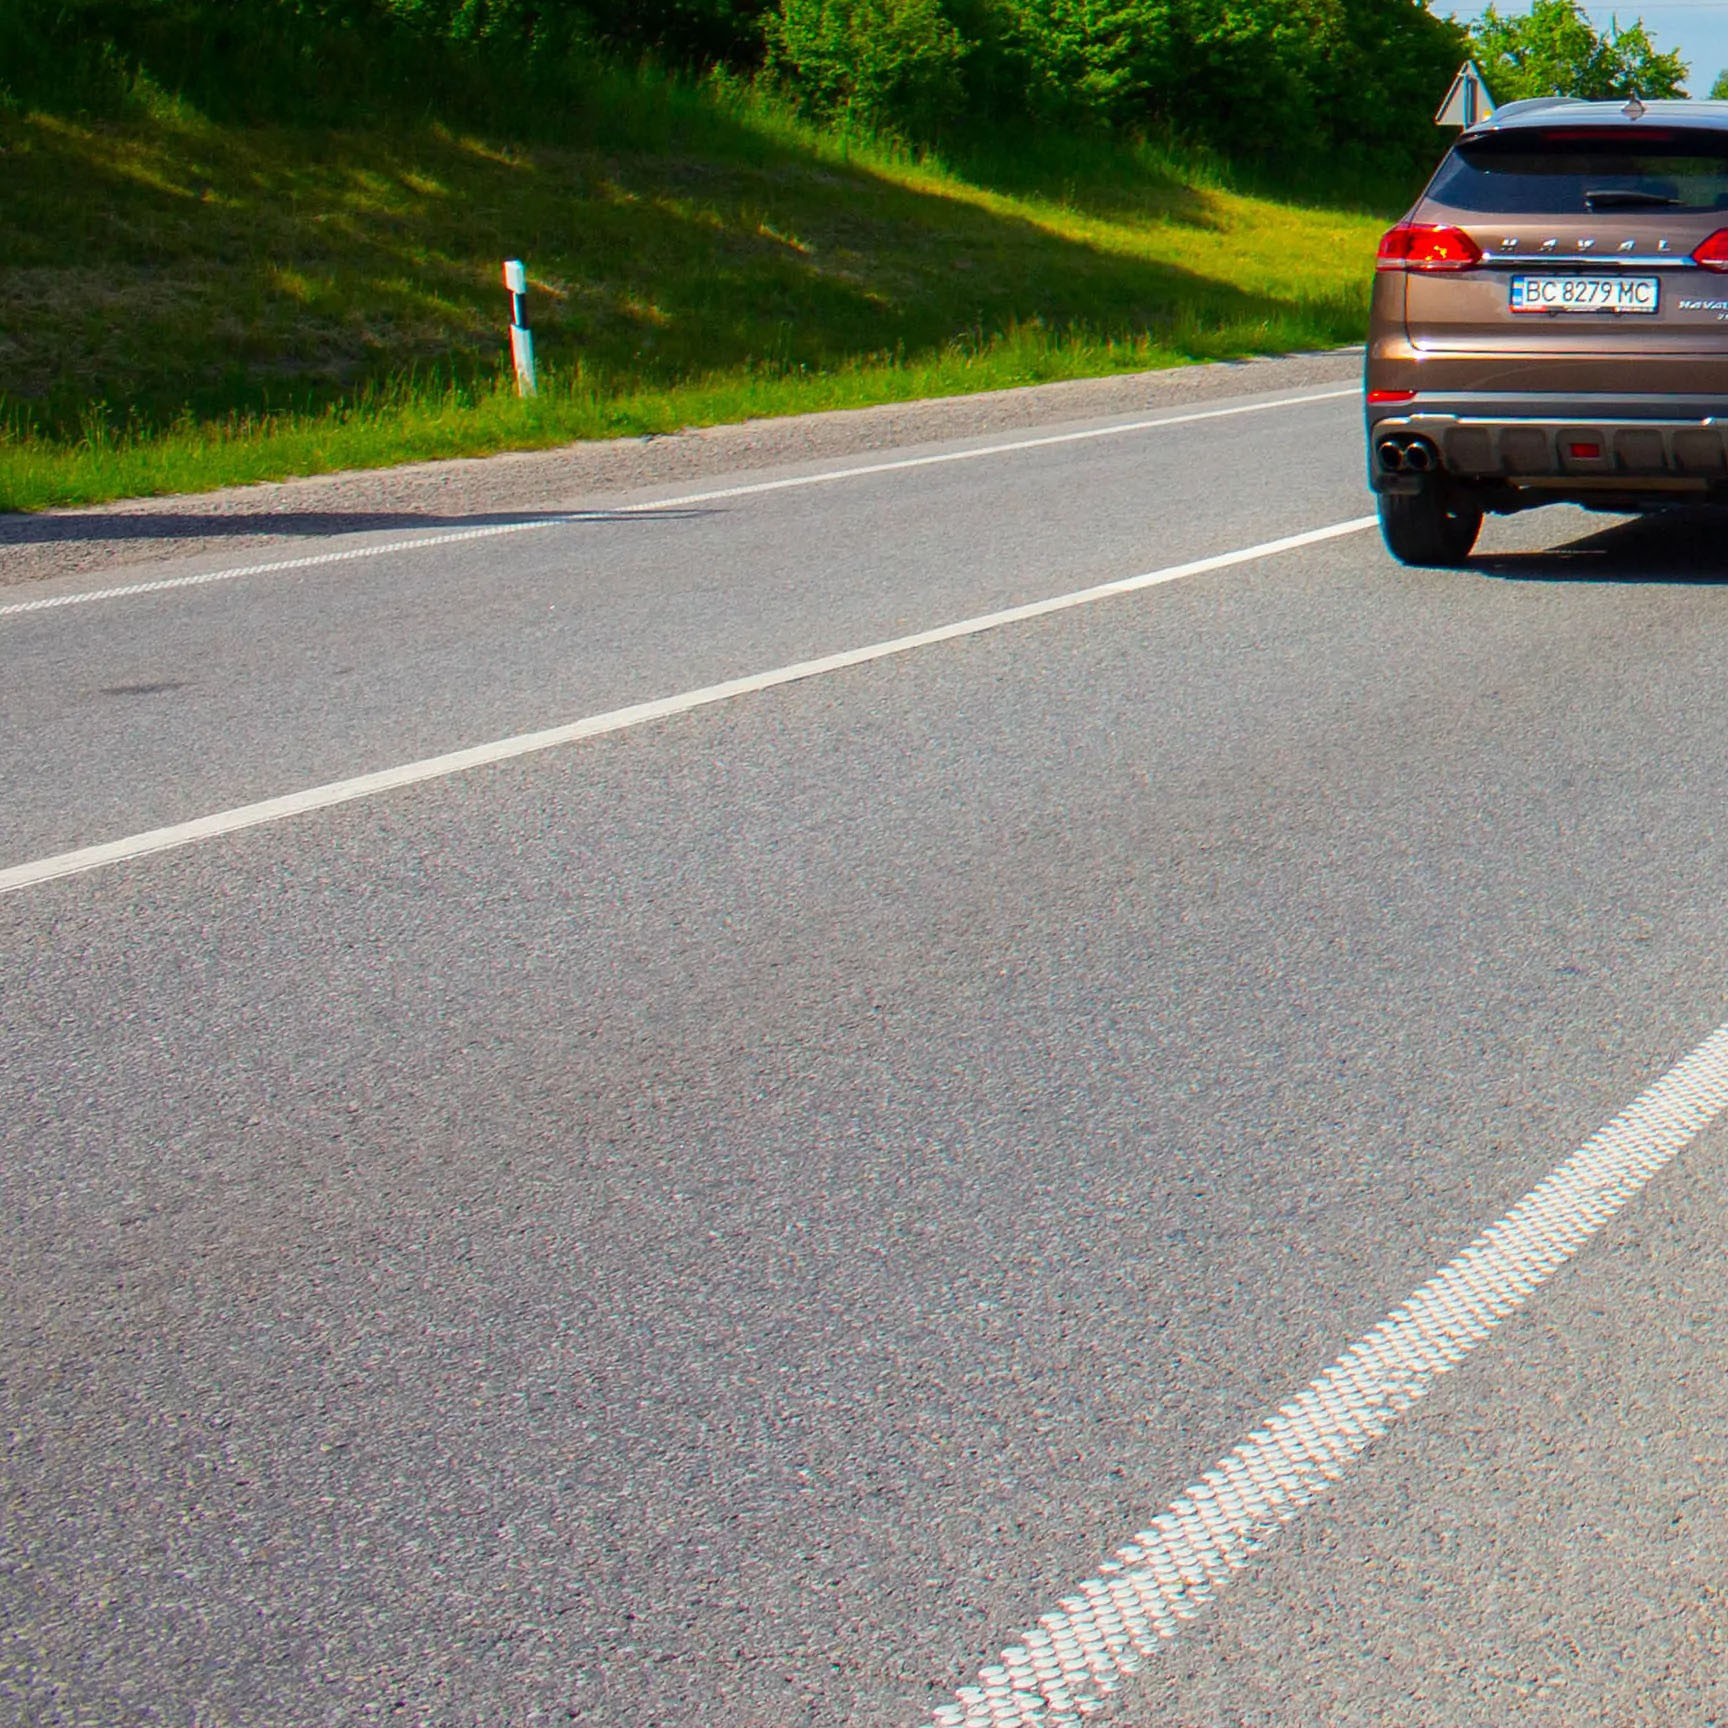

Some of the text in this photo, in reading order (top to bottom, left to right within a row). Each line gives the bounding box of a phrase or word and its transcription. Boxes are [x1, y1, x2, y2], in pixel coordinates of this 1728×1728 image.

[1500, 237, 1672, 252] HAVAL
[1526, 280, 1651, 304] BC 8279 MC
